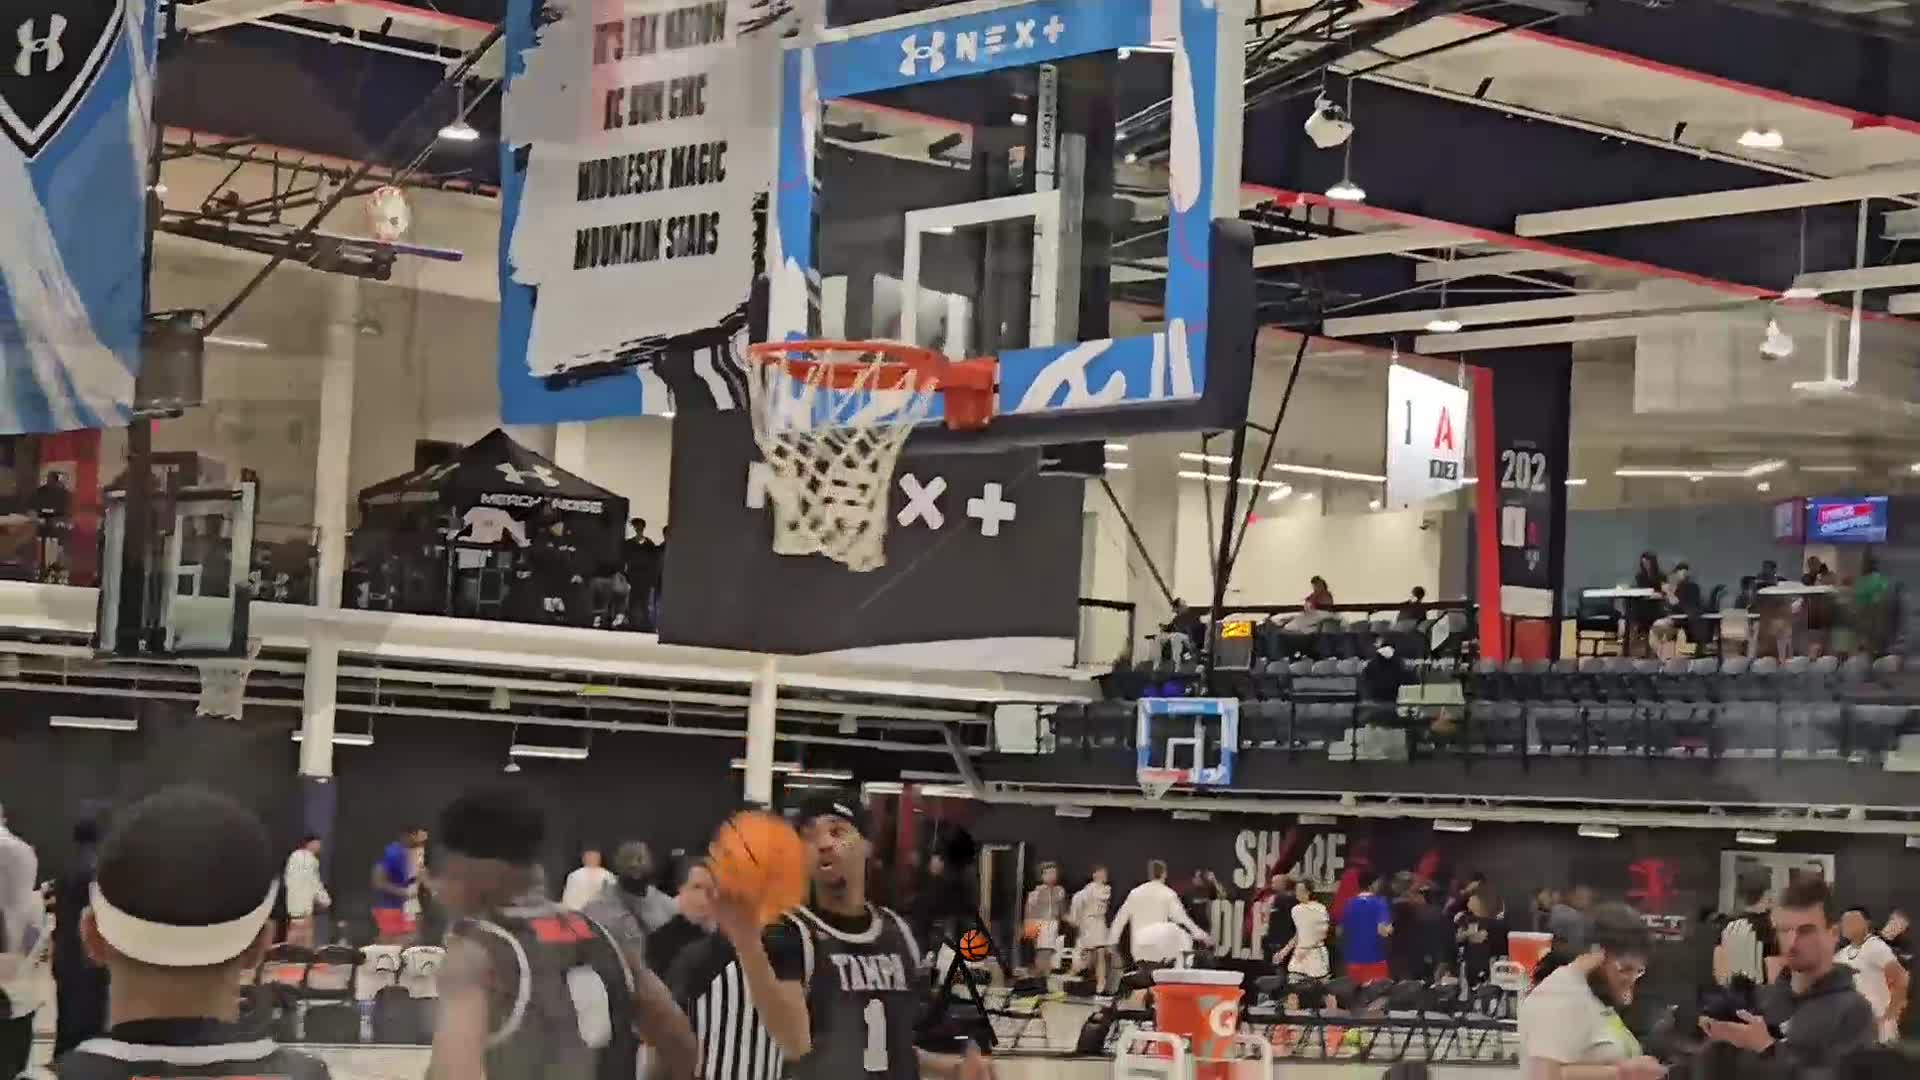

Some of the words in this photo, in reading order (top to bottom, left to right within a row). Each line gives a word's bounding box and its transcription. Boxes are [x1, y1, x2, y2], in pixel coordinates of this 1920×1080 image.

[669, 140, 728, 189] MAGIC
[573, 219, 662, 270] MOUNTAIN
[1500, 449, 1547, 492] 202
[863, 999, 889, 1072] 1
